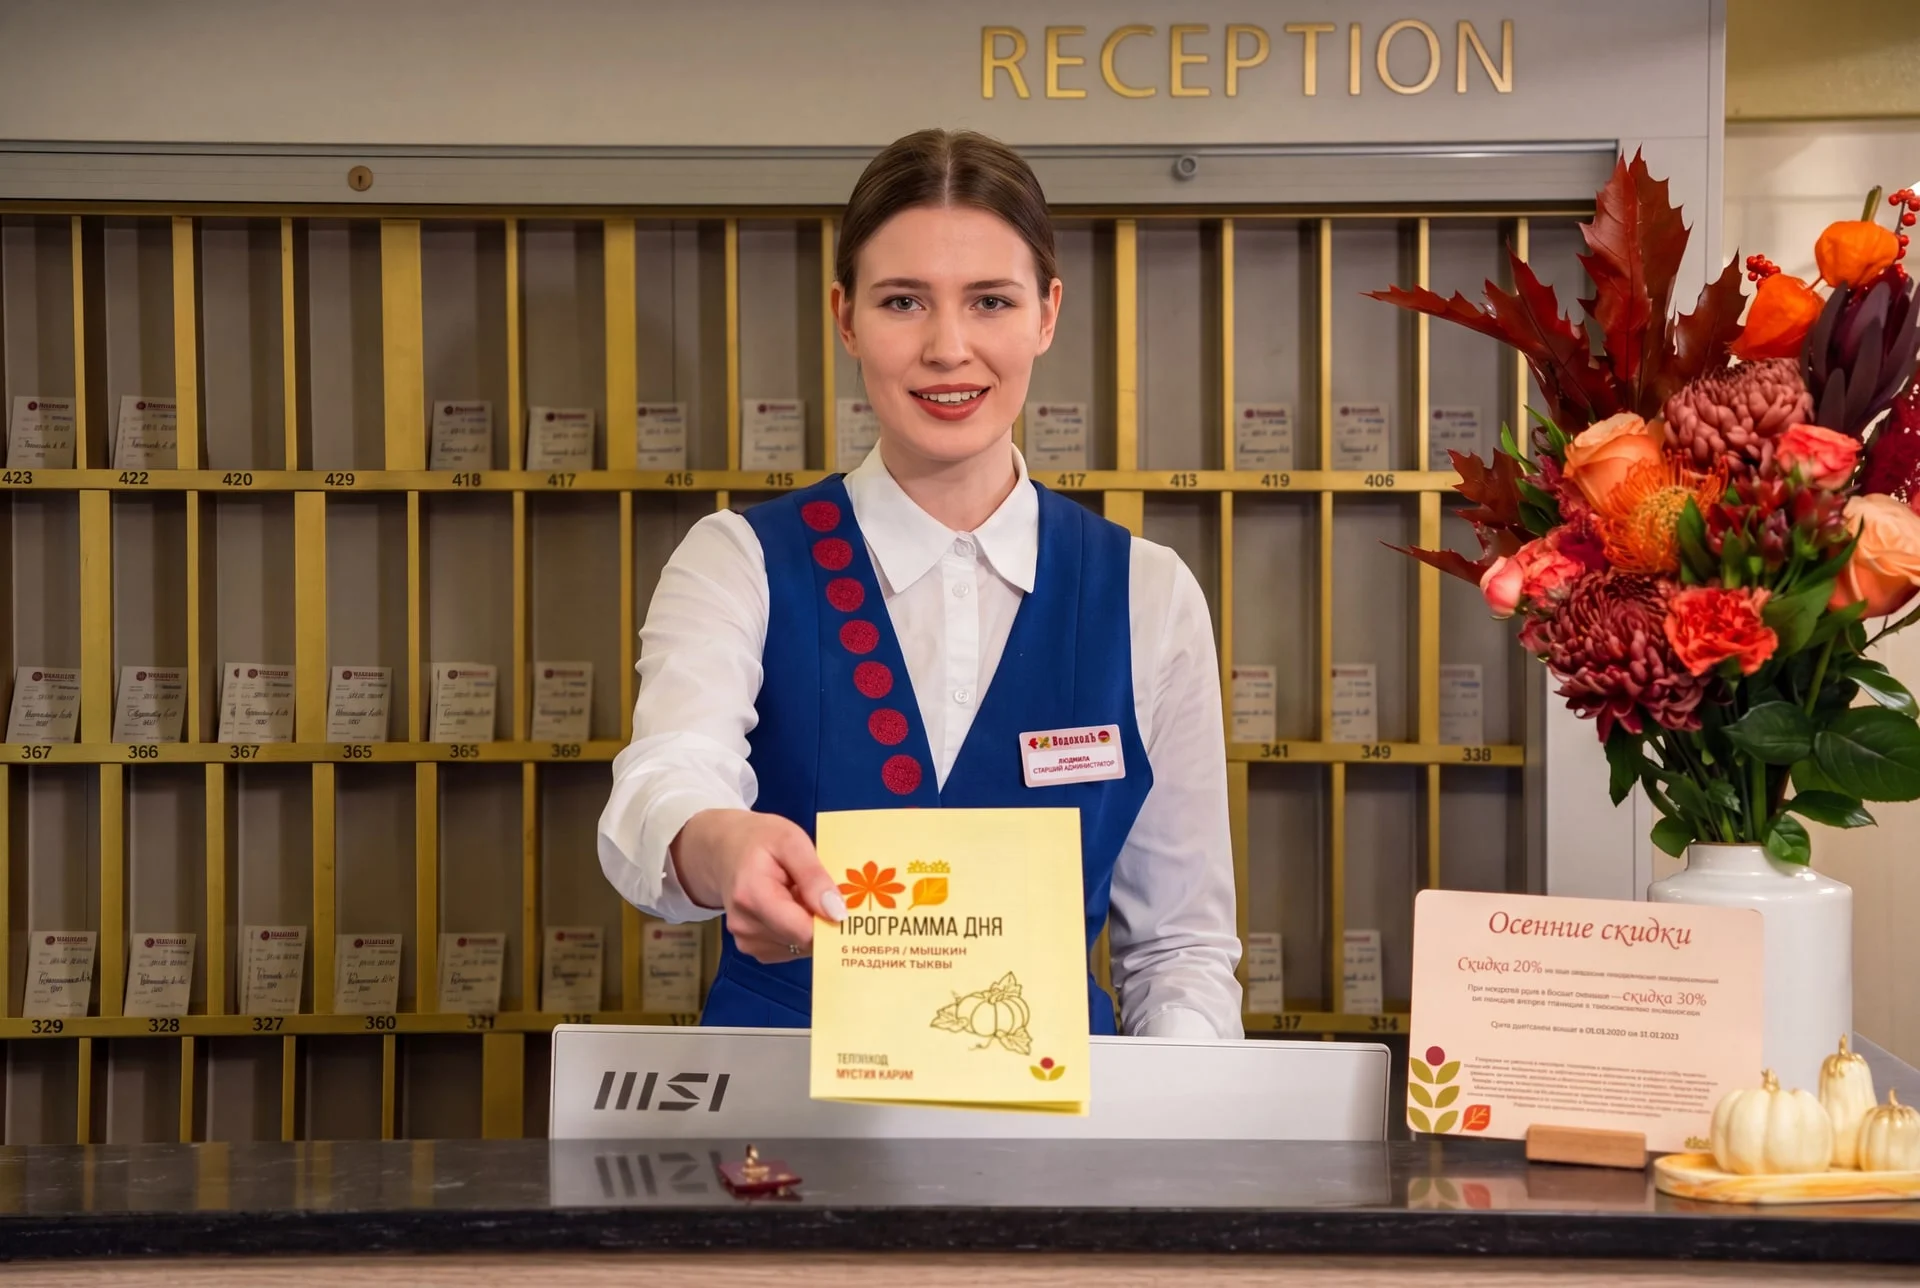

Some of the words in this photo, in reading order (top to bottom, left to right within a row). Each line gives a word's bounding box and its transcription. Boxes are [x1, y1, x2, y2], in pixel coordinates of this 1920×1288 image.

[980, 19, 1515, 100] RECEPTION
[2, 471, 33, 485] 423
[118, 471, 149, 485] 422
[222, 472, 253, 486] 420
[325, 472, 356, 486] 429
[452, 472, 482, 487] 418
[547, 472, 576, 487] 417
[665, 472, 694, 487] 416
[765, 471, 794, 487] 415
[1057, 473, 1086, 488] 417
[1170, 473, 1197, 487] 413
[1260, 473, 1290, 488] 419
[1364, 473, 1394, 487] 406
[21, 745, 53, 759] 367
[127, 745, 159, 759] 366
[229, 745, 260, 759] 367
[342, 744, 373, 759] 365
[449, 744, 480, 758] 365
[551, 744, 581, 758] 369
[1260, 744, 1289, 758] 341
[1361, 745, 1391, 759] 349
[1462, 748, 1492, 762] 338
[1033, 765, 1064, 775] СТАРШИЙ
[1064, 760, 1115, 772] АДМИНИСТРАТОР
[840, 915, 958, 936] ПРОГРАММА
[963, 916, 1003, 939] ДНЯ
[1488, 910, 1595, 939] Осенние
[1601, 917, 1693, 950] скидки
[841, 945, 849, 954] 6
[852, 945, 900, 955] НОЯБРЯ
[909, 946, 967, 956] МЫШКИН
[841, 958, 907, 969] ПРАЗДНИК
[909, 959, 953, 969] ТЫКВЫ
[1457, 956, 1510, 974] Скидка
[1513, 959, 1543, 974] 20%
[1622, 989, 1673, 1007] скидка
[1676, 992, 1707, 1006] 30%
[31, 1019, 64, 1034] 329
[148, 1018, 180, 1033] 328
[252, 1017, 284, 1031] 327
[365, 1016, 397, 1030] 360
[1273, 1015, 1302, 1030] 317
[1368, 1016, 1398, 1031] 314
[593, 1071, 731, 1112] MSI
